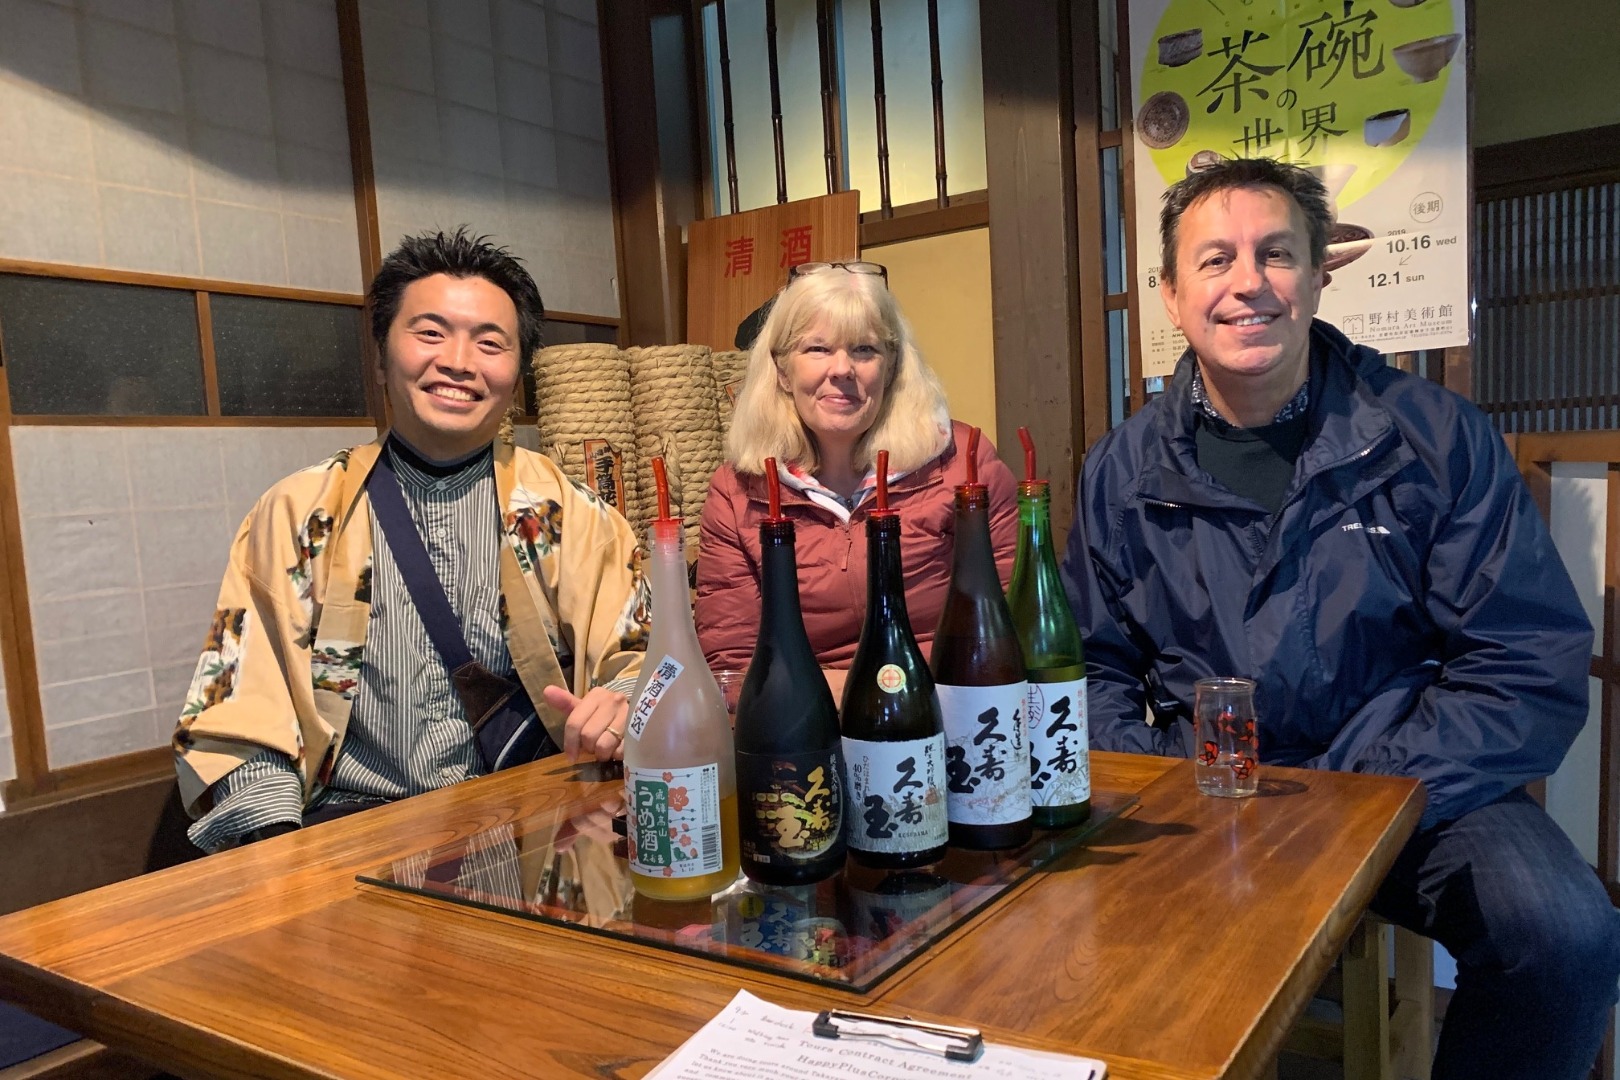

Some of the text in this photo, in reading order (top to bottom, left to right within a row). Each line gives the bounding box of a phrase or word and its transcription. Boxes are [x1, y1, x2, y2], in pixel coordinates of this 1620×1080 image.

[1196, 0, 1385, 113] 茶碗
[1276, 88, 1298, 111] の
[1232, 101, 1350, 159] 世界
[1412, 199, 1440, 215] 後期
[724, 225, 813, 279] 清酒
[1386, 234, 1457, 254] 10.16 wed
[1148, 275, 1161, 288] 8.
[1368, 271, 1425, 288] 12.1 sun
[1369, 304, 1453, 325] 野村美術館
[1369, 325, 1400, 333] Nomura
[1420, 319, 1452, 327] Museum
[638, 786, 658, 852] うめ酒
[800, 1040, 833, 1053] Tours
[839, 1049, 895, 1065] Contract
[897, 1061, 972, 1079] Agreement
